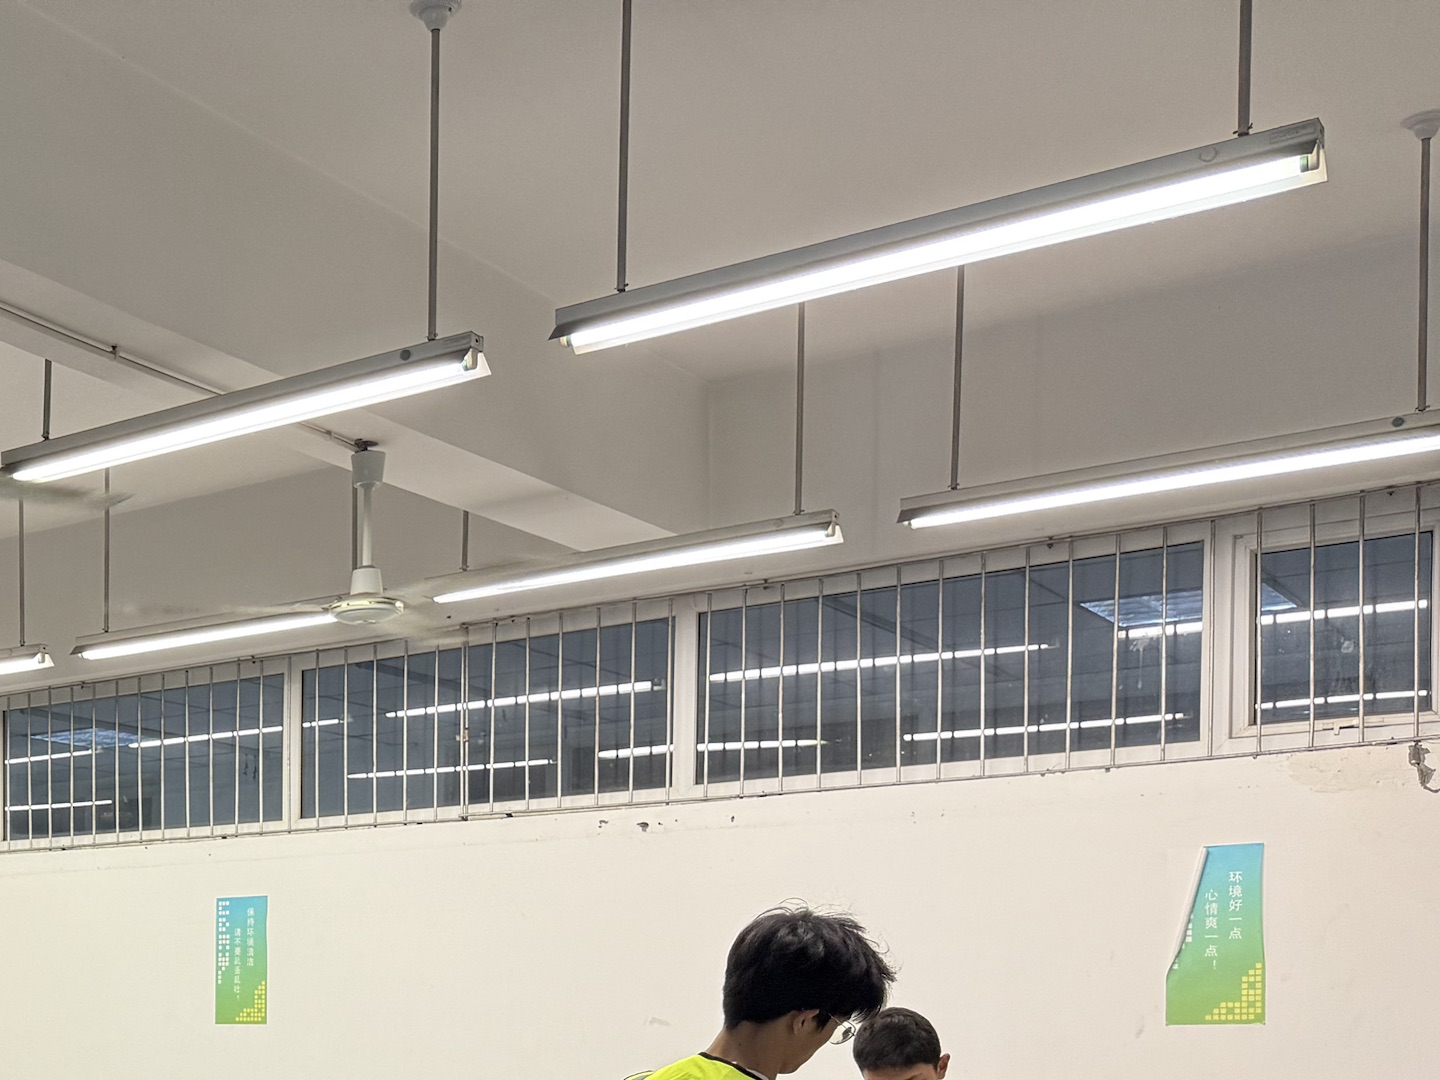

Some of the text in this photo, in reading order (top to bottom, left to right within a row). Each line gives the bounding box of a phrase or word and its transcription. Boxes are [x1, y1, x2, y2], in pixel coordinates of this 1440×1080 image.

[1228, 871, 1243, 940] 环境好一点
